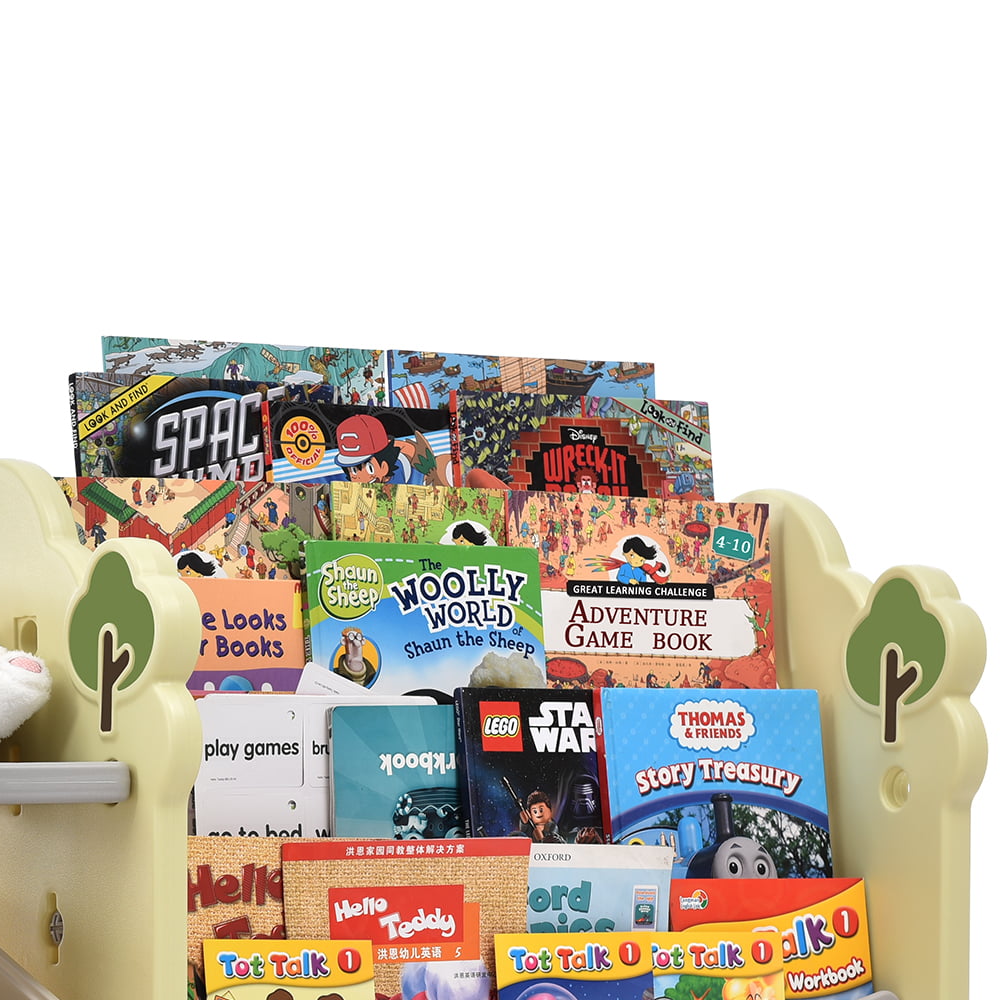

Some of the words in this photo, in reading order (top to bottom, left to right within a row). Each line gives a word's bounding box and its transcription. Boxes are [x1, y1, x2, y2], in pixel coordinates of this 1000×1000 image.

[84, 410, 109, 431] LOOK
[110, 398, 128, 416] AND
[129, 384, 148, 402] FIND
[154, 386, 286, 476] SPAC
[286, 420, 318, 440] 100%
[641, 400, 666, 424] Look
[677, 424, 702, 445] Find
[286, 447, 321, 466] OFFICIAL
[321, 560, 378, 585] Shaun
[420, 559, 442, 570] The
[327, 586, 378, 610] Sheep
[343, 581, 359, 592] the
[392, 568, 525, 612] WOOLLY
[573, 585, 604, 594] GREAT
[606, 586, 652, 596] LEARNING
[654, 587, 708, 597] CHALLENGE
[222, 609, 287, 631] Looks
[425, 600, 513, 630] WORLD
[512, 626, 524, 638] of
[569, 600, 707, 627] ADVENTURE
[216, 635, 284, 658] Books
[404, 636, 452, 660] Shaun
[456, 630, 484, 646] the
[488, 632, 535, 659] Sheep
[653, 633, 712, 650] BOOK
[484, 717, 518, 735] LEGO
[678, 712, 746, 726] THOMAS
[684, 729, 692, 738] &
[696, 728, 742, 738] FRIENDS
[205, 738, 239, 761] play
[244, 742, 300, 761] games
[636, 762, 696, 794] Story
[698, 758, 802, 796] Treasury
[334, 897, 388, 922] Hello
[379, 908, 456, 940] Teddy
[760, 915, 834, 959] alk
[218, 953, 264, 978] Tot
[269, 950, 329, 978] Talk
[378, 947, 442, 960] 洪恩幼儿英语
[455, 947, 462, 958] 5
[508, 948, 552, 972] Tot
[556, 944, 612, 970] Talk
[689, 942, 744, 968] Talk
[787, 957, 865, 993] Workbook
